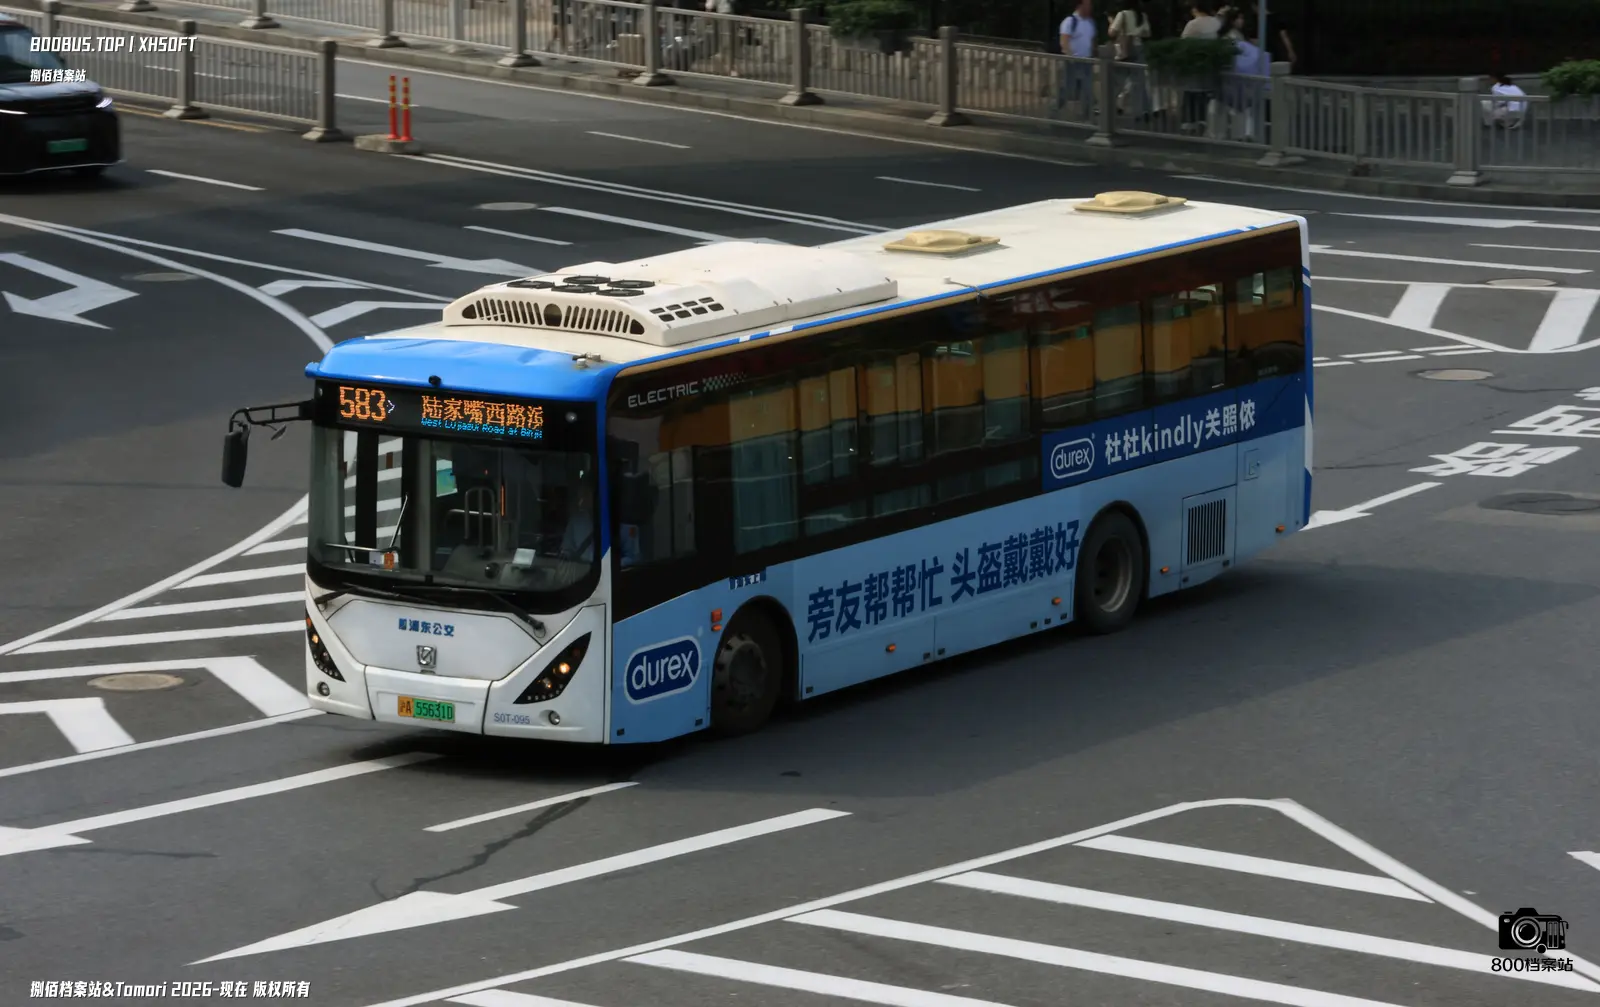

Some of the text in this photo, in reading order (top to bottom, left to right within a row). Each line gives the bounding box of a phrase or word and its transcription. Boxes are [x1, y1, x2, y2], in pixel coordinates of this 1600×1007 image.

[338, 386, 387, 422] 583
[627, 381, 699, 408] ELECTRIC
[420, 417, 443, 428] West
[482, 423, 506, 435] Road
[508, 427, 519, 436] at
[1104, 398, 1257, 465] 杜杜kindly关照侬
[1054, 446, 1092, 471] durex
[806, 518, 1081, 644] 旁友帮帮忙 头盔戴戴好
[632, 650, 694, 690] durex
